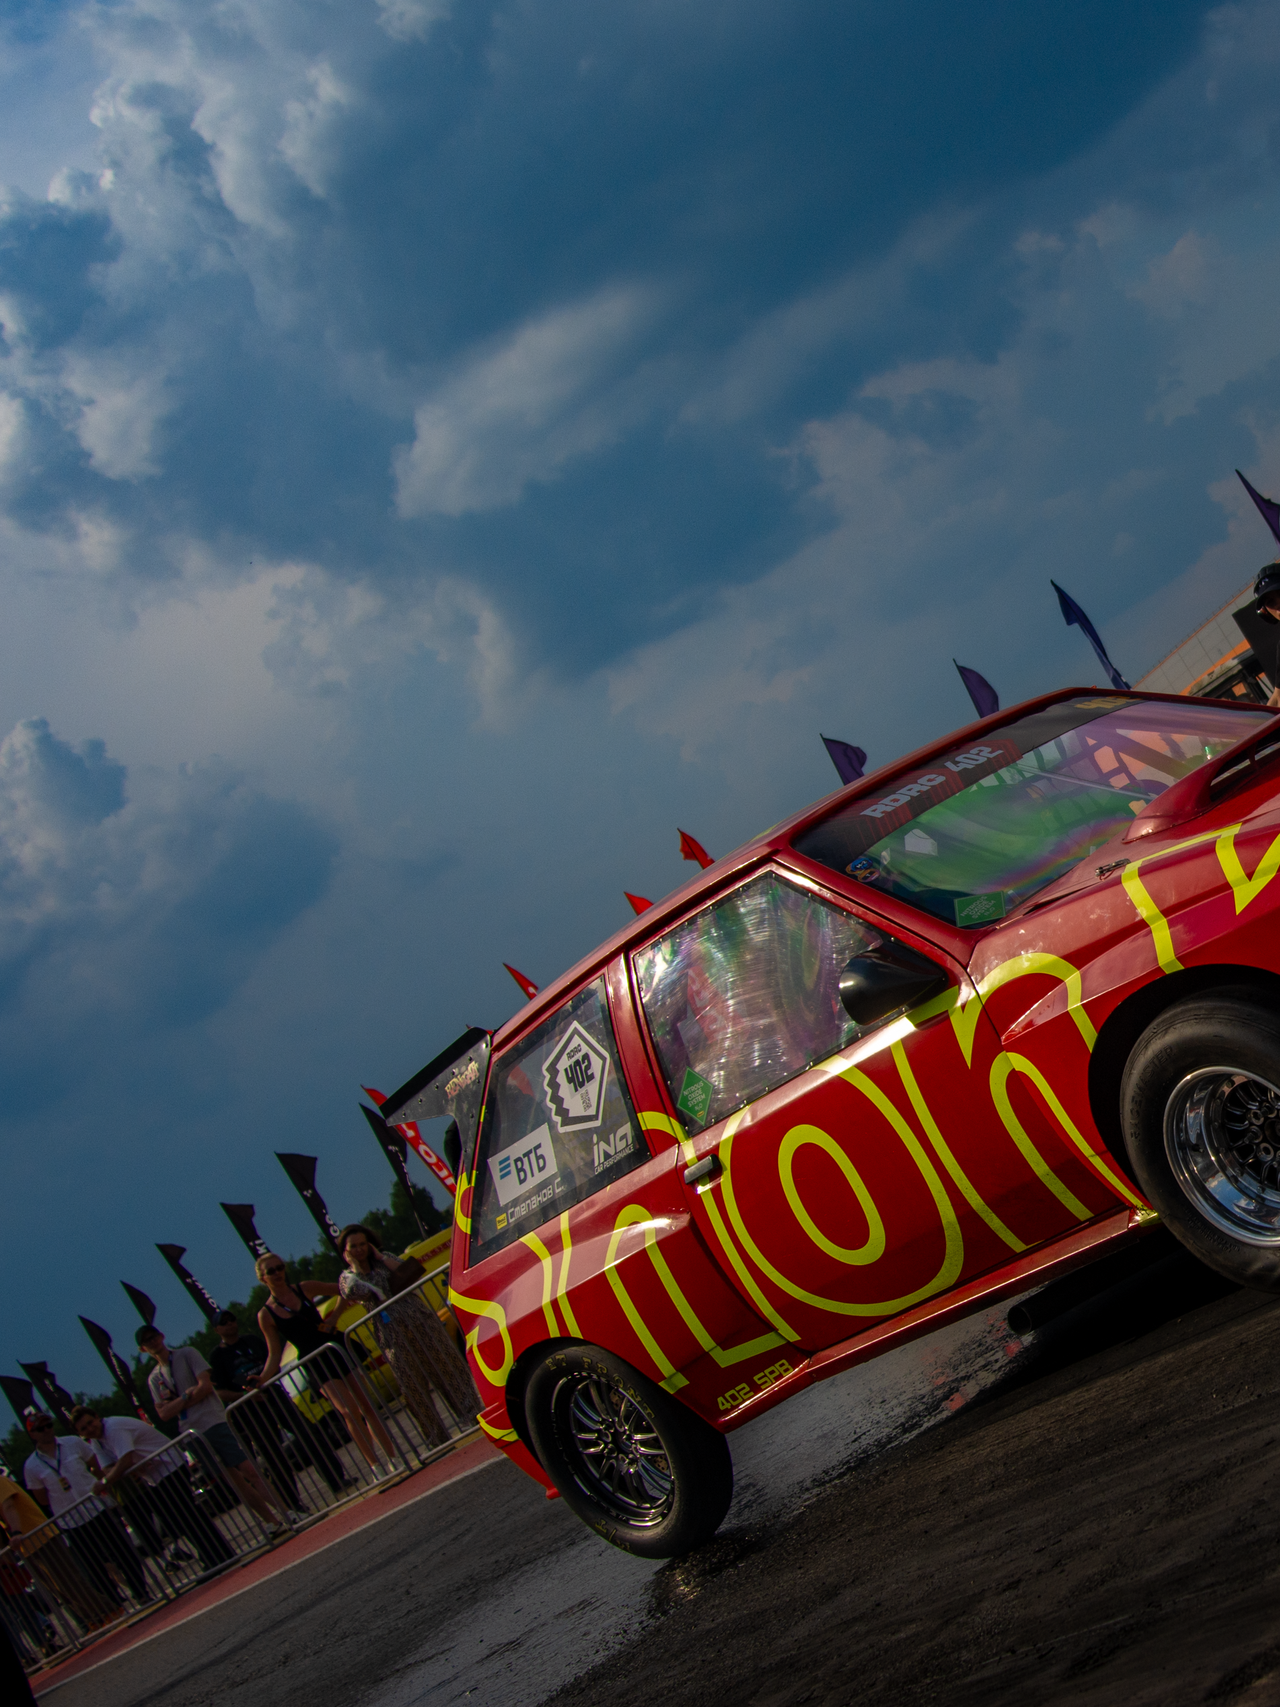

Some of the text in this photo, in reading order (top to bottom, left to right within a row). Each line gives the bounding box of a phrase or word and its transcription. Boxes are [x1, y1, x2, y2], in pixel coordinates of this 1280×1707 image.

[860, 745, 1004, 818] RDRC 402
[564, 1052, 596, 1093] 402
[513, 1142, 547, 1186] ВТБ
[603, 1143, 634, 1169] PERFORMANCE
[717, 1358, 794, 1411] 402 SPB
